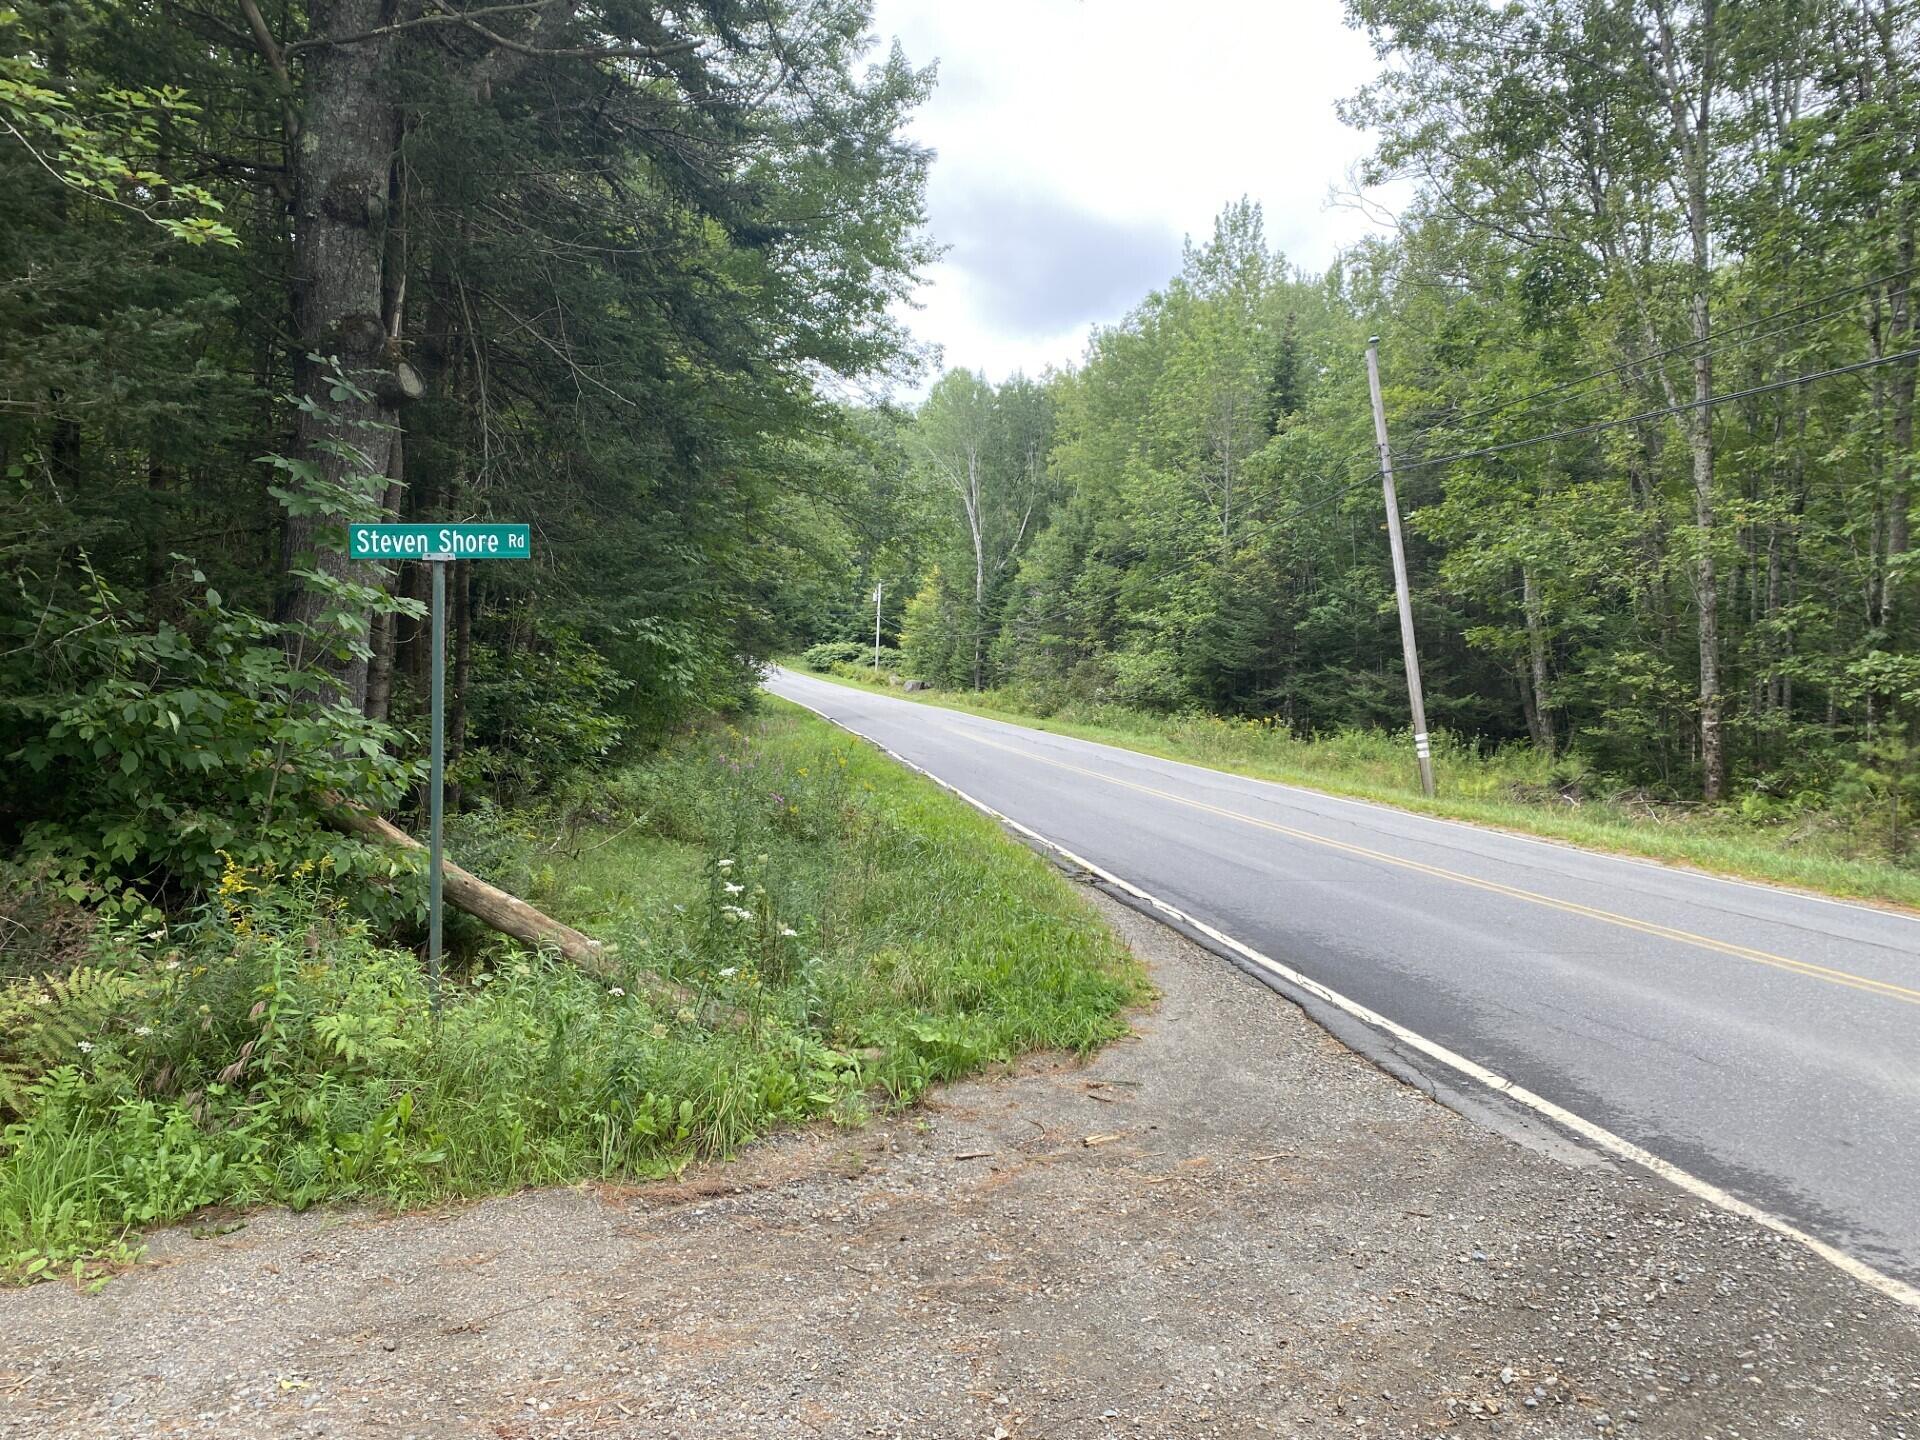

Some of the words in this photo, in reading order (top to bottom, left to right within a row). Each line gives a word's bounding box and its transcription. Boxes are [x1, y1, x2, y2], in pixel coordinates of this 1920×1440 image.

[356, 529, 428, 553] Steven
[439, 529, 499, 553] Shore
[508, 533, 525, 548] Rd
